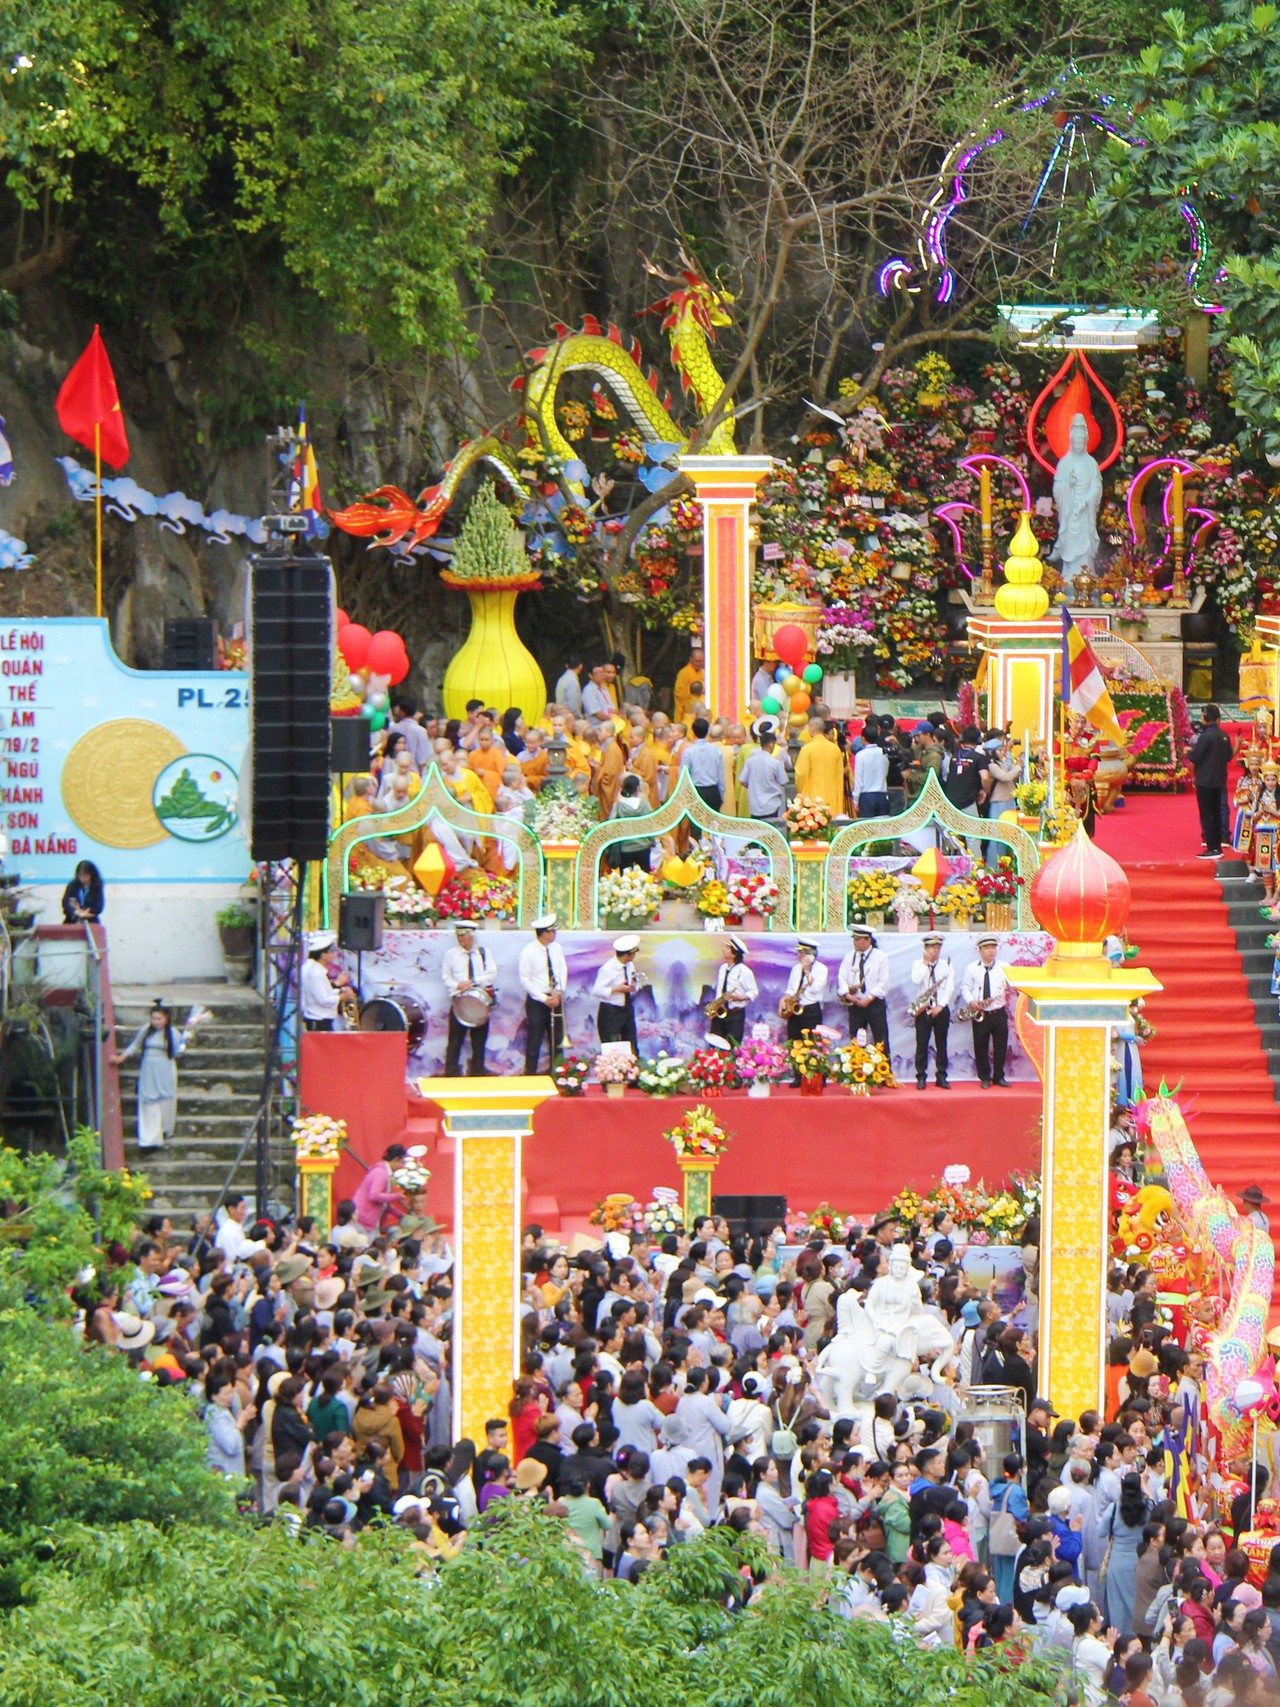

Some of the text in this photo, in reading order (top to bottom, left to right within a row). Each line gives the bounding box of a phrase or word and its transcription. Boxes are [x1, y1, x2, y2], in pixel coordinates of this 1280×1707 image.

[20, 631, 44, 652] HỘI
[2, 656, 42, 676] QUÁN
[11, 708, 35, 727] ÂM
[6, 737, 39, 753] 19/2
